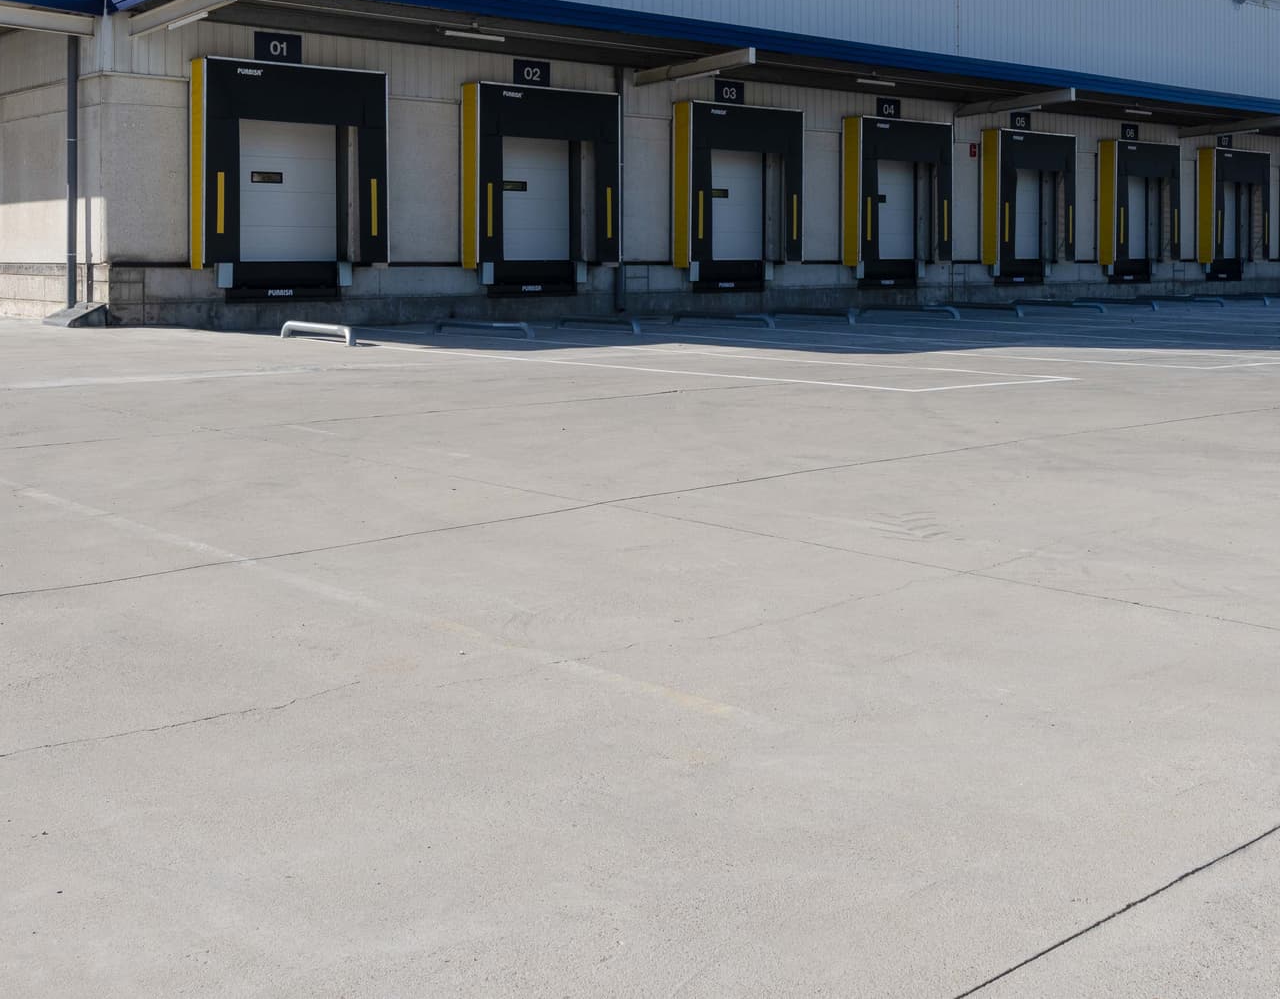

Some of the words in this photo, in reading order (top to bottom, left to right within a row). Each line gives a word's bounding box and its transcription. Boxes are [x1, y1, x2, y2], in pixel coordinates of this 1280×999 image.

[270, 41, 287, 56] 01
[524, 67, 540, 81] 02
[723, 87, 736, 99] 03
[883, 104, 894, 116] 04
